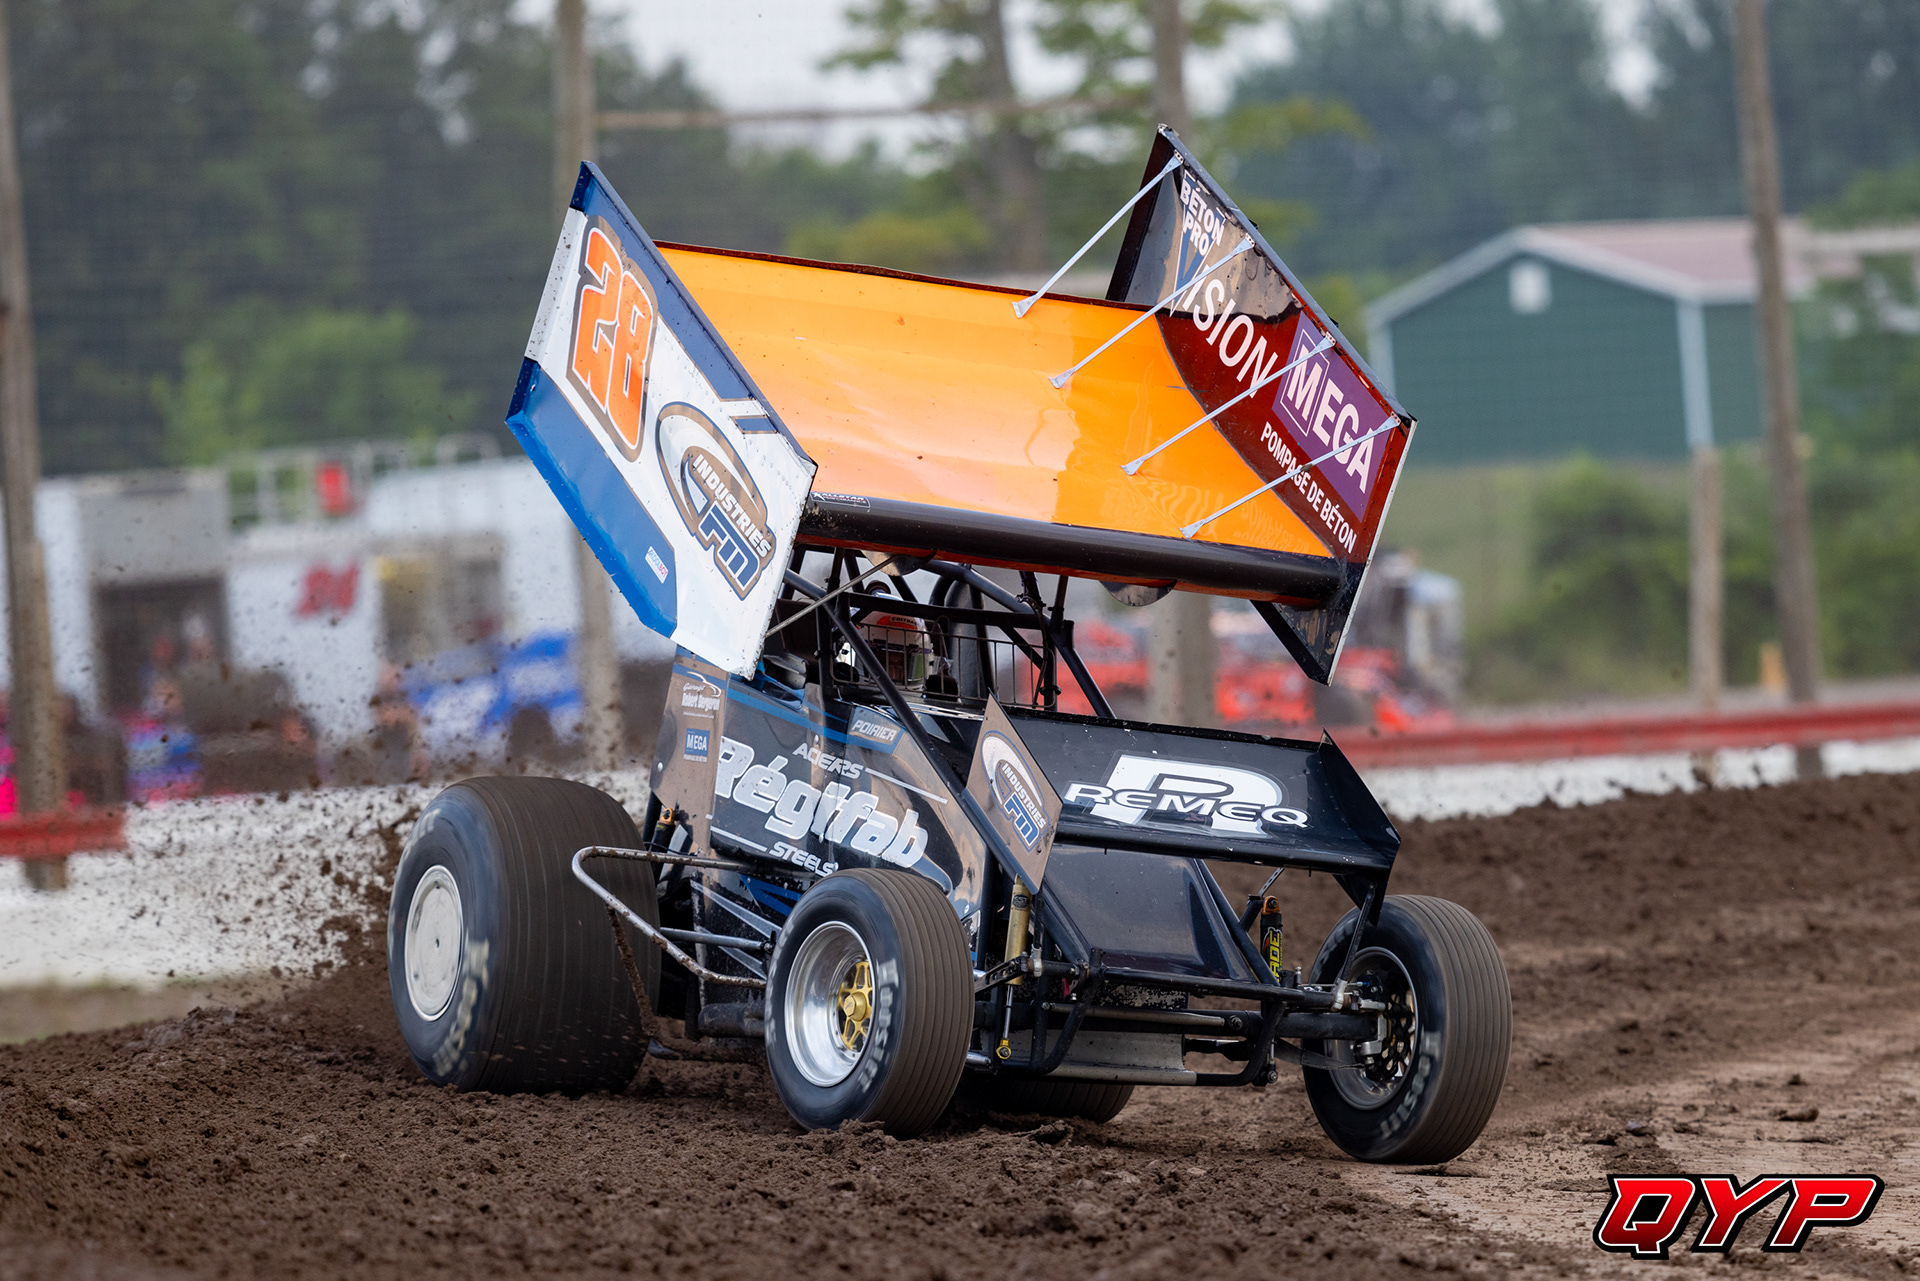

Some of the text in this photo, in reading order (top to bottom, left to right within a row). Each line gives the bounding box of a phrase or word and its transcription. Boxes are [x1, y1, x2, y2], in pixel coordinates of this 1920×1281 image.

[1180, 179, 1224, 246] BÉTON
[1183, 210, 1210, 256] PRO
[572, 227, 653, 450] 28
[1287, 344, 1375, 494] MEGA
[692, 453, 772, 558] INDUSTRIES
[1260, 421, 1312, 495] POMPAGE
[1306, 477, 1325, 514] DE
[1319, 498, 1358, 553] BÉTON
[686, 734, 708, 751] MEGA
[792, 742, 866, 780] ACIERS
[851, 719, 898, 741] POIRIER
[714, 736, 928, 868] Régifab
[1001, 762, 1047, 829] INDUSTRIES
[1063, 783, 1310, 829] REMEQ
[768, 841, 836, 878] STEELS
